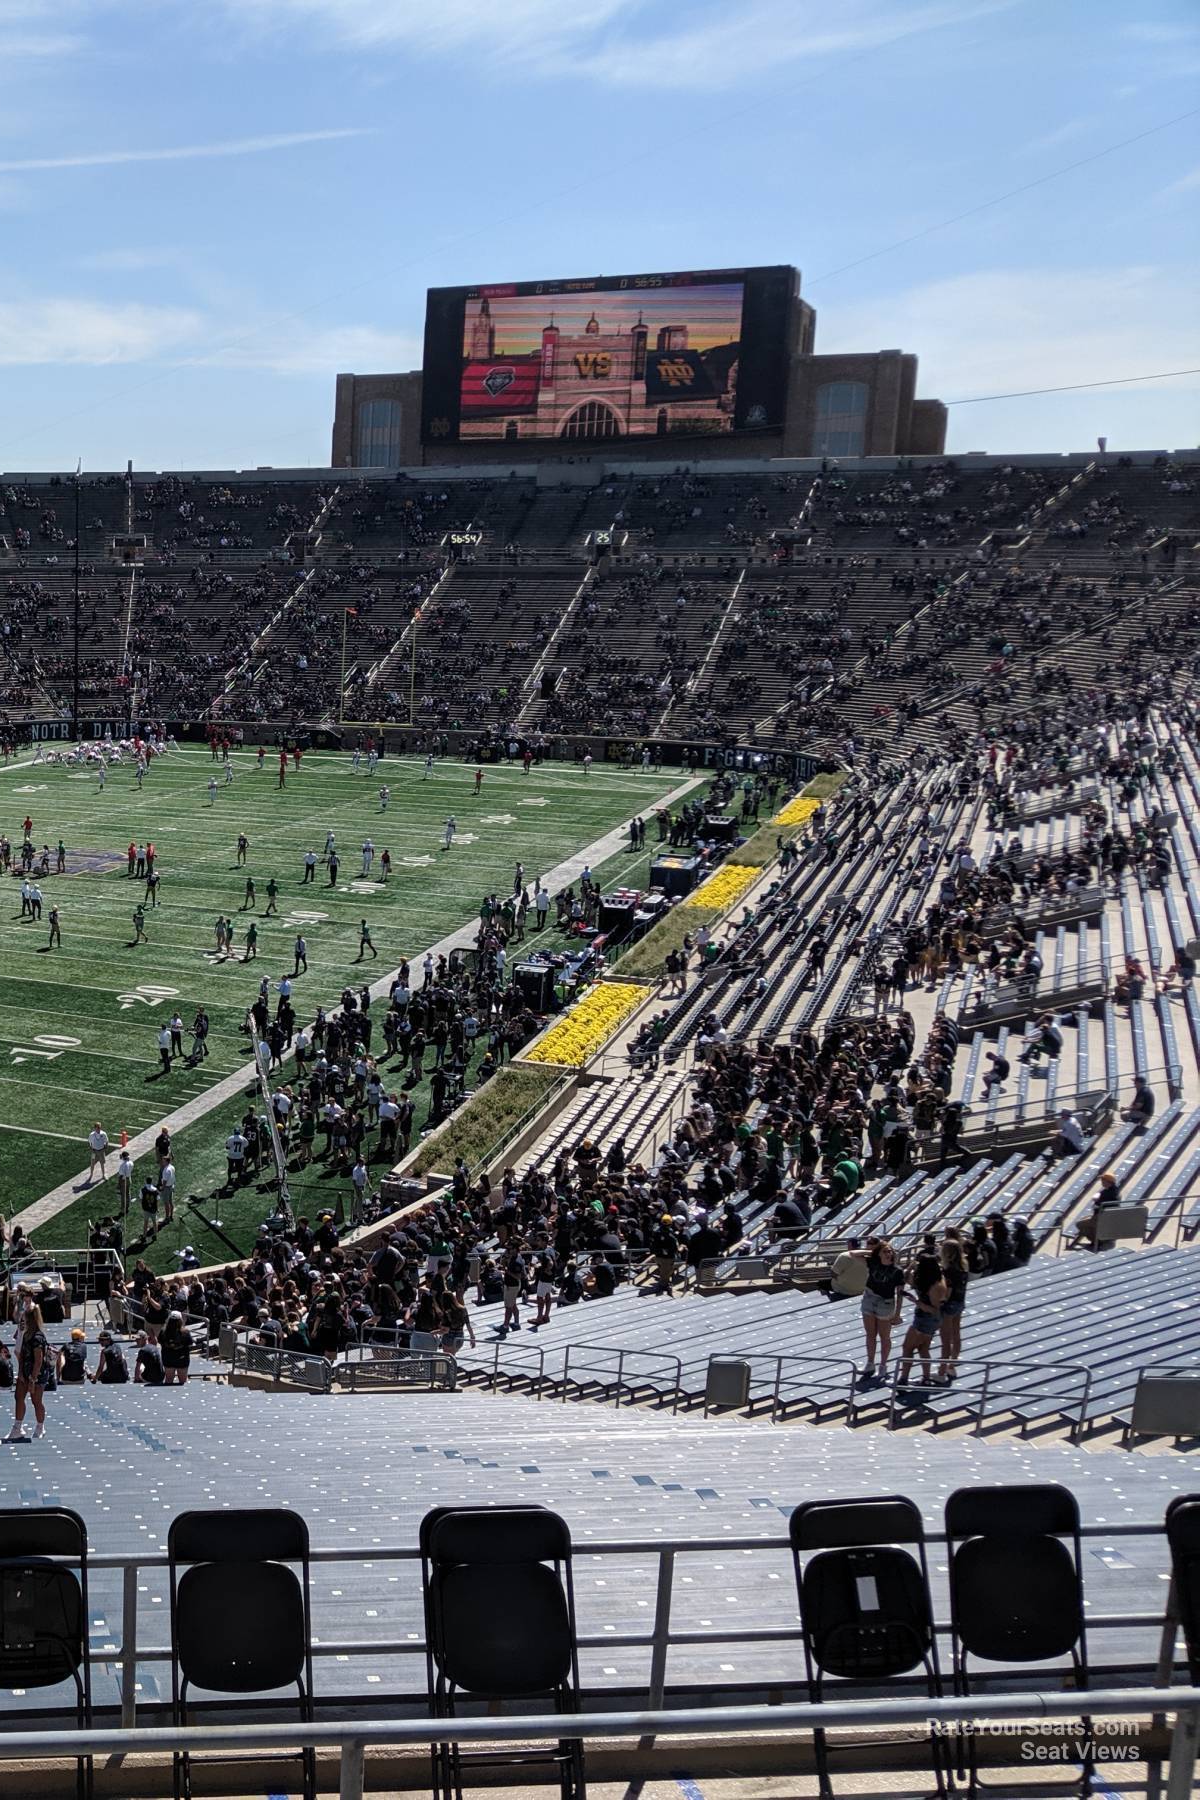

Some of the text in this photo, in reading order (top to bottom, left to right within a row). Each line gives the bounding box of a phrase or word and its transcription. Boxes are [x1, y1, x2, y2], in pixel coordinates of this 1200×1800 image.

[575, 352, 611, 379] VS
[451, 534, 477, 544] 56:54
[596, 533, 610, 543] 25
[31, 723, 71, 741] NOTR
[116, 985, 180, 1007] 20
[10, 1034, 82, 1061] 10
[233, 1141, 242, 1152] 77
